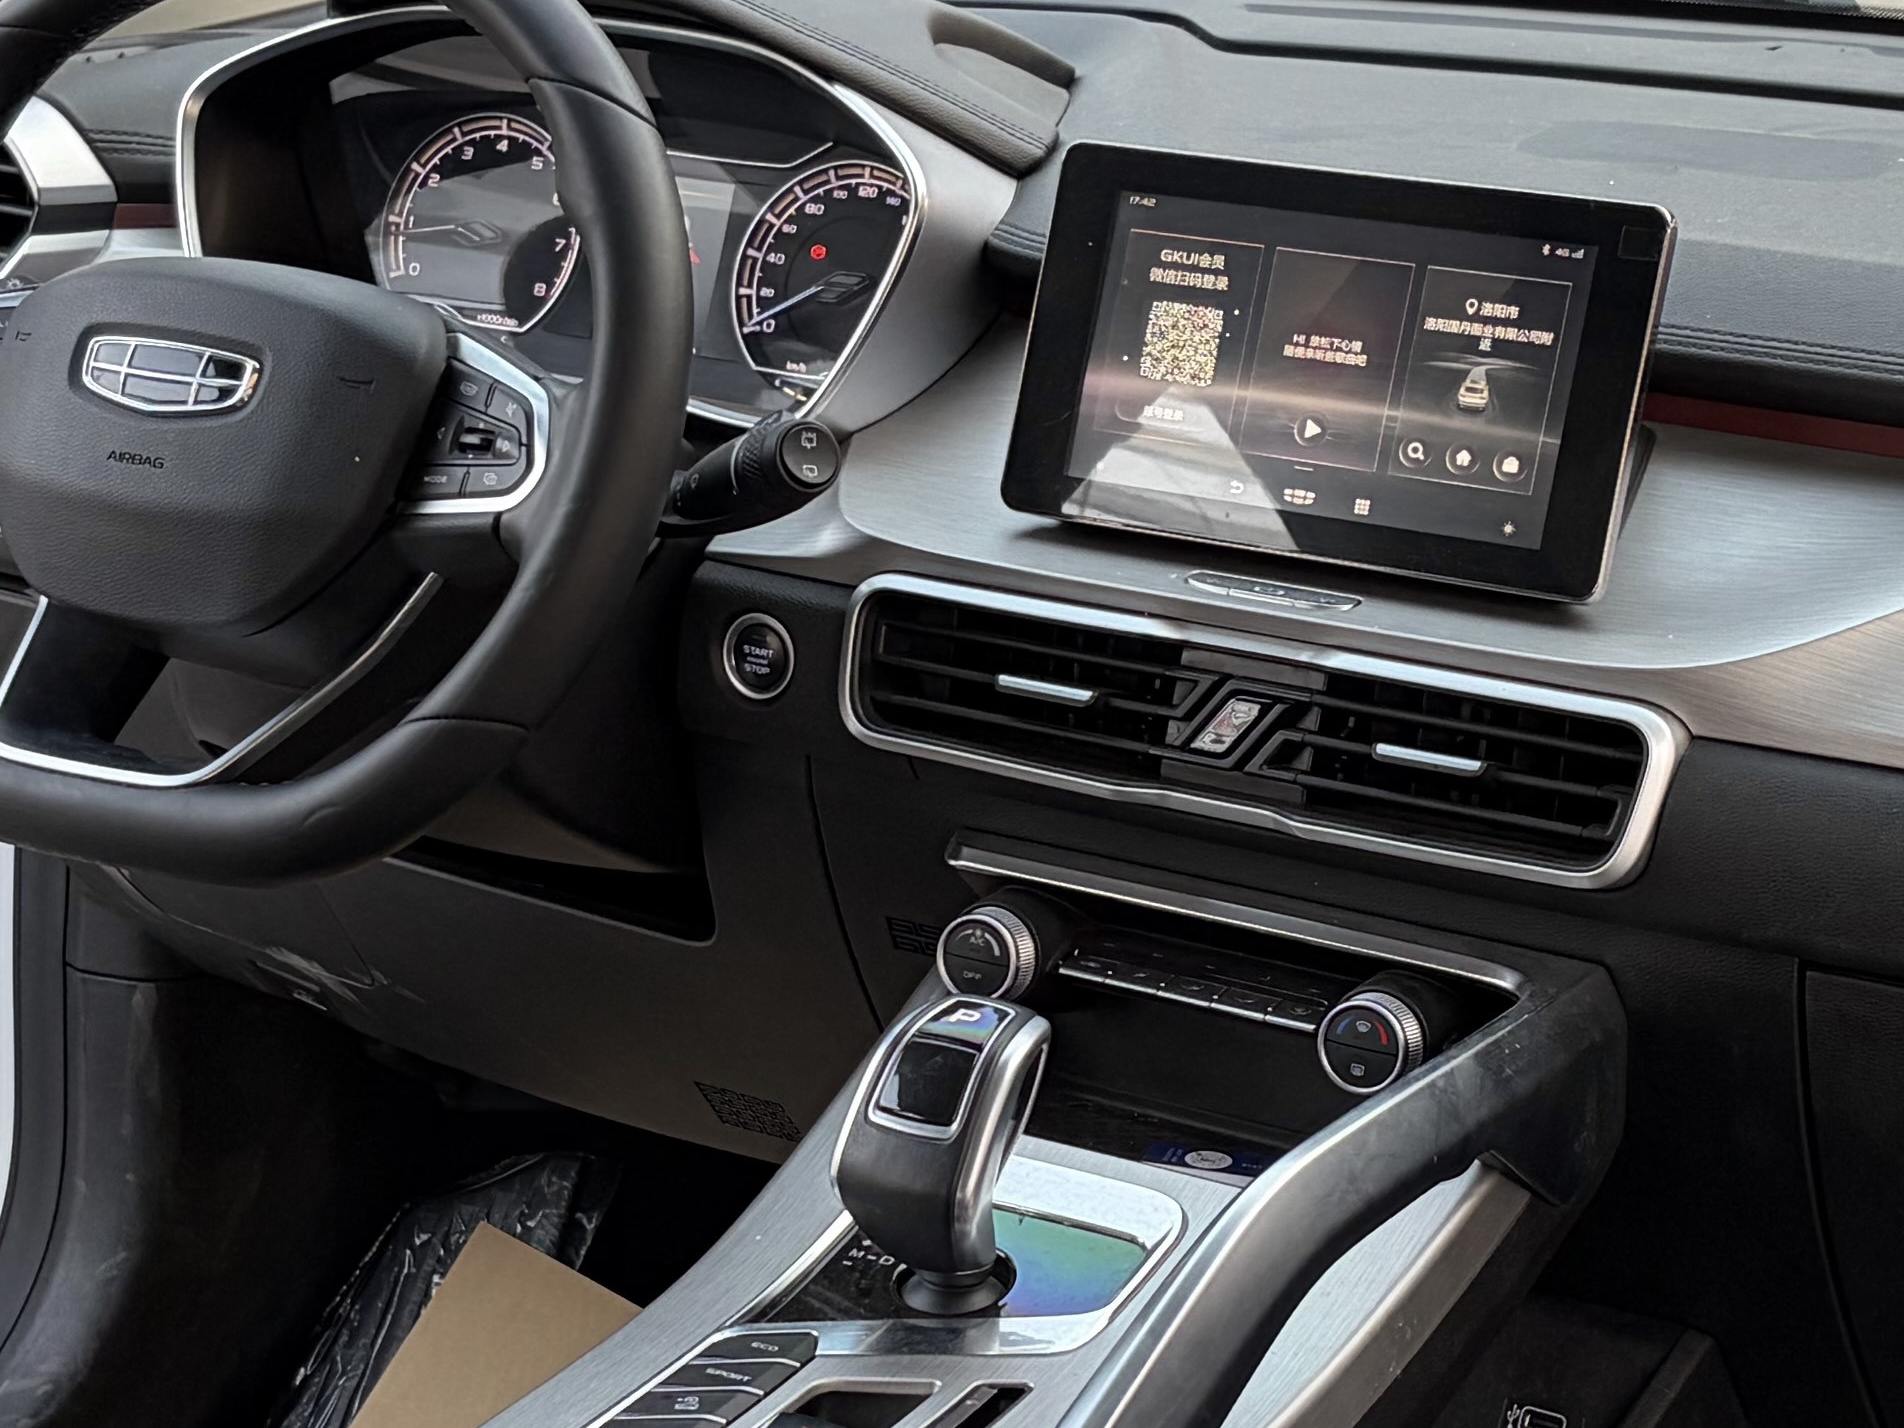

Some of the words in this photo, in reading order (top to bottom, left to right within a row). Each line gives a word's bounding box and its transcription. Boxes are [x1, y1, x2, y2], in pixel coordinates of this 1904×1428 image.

[461, 145, 474, 160] 3
[496, 139, 509, 152] 4
[531, 156, 543, 170] 5
[427, 173, 440, 188] 2
[832, 189, 848, 200] 100
[857, 186, 878, 199] 120
[804, 202, 825, 215] 80
[408, 215, 415, 228] 1
[781, 223, 797, 234] 60
[554, 238, 566, 252] 7
[765, 252, 786, 266] 40
[1160, 248, 1226, 270] GKUI会员
[408, 262, 420, 277] 0
[1148, 266, 1230, 291] 微信扫码登录
[533, 282, 546, 297] 8
[760, 286, 775, 298] 20
[1479, 301, 1520, 320] 洛阳市
[762, 319, 776, 333] 0
[106, 450, 166, 470] AIRBAG
[743, 644, 774, 658] START
[744, 662, 771, 675] STOP
[948, 1008, 982, 1023] P
[751, 1341, 780, 1353] ECO
[705, 1368, 753, 1383] SPORT
